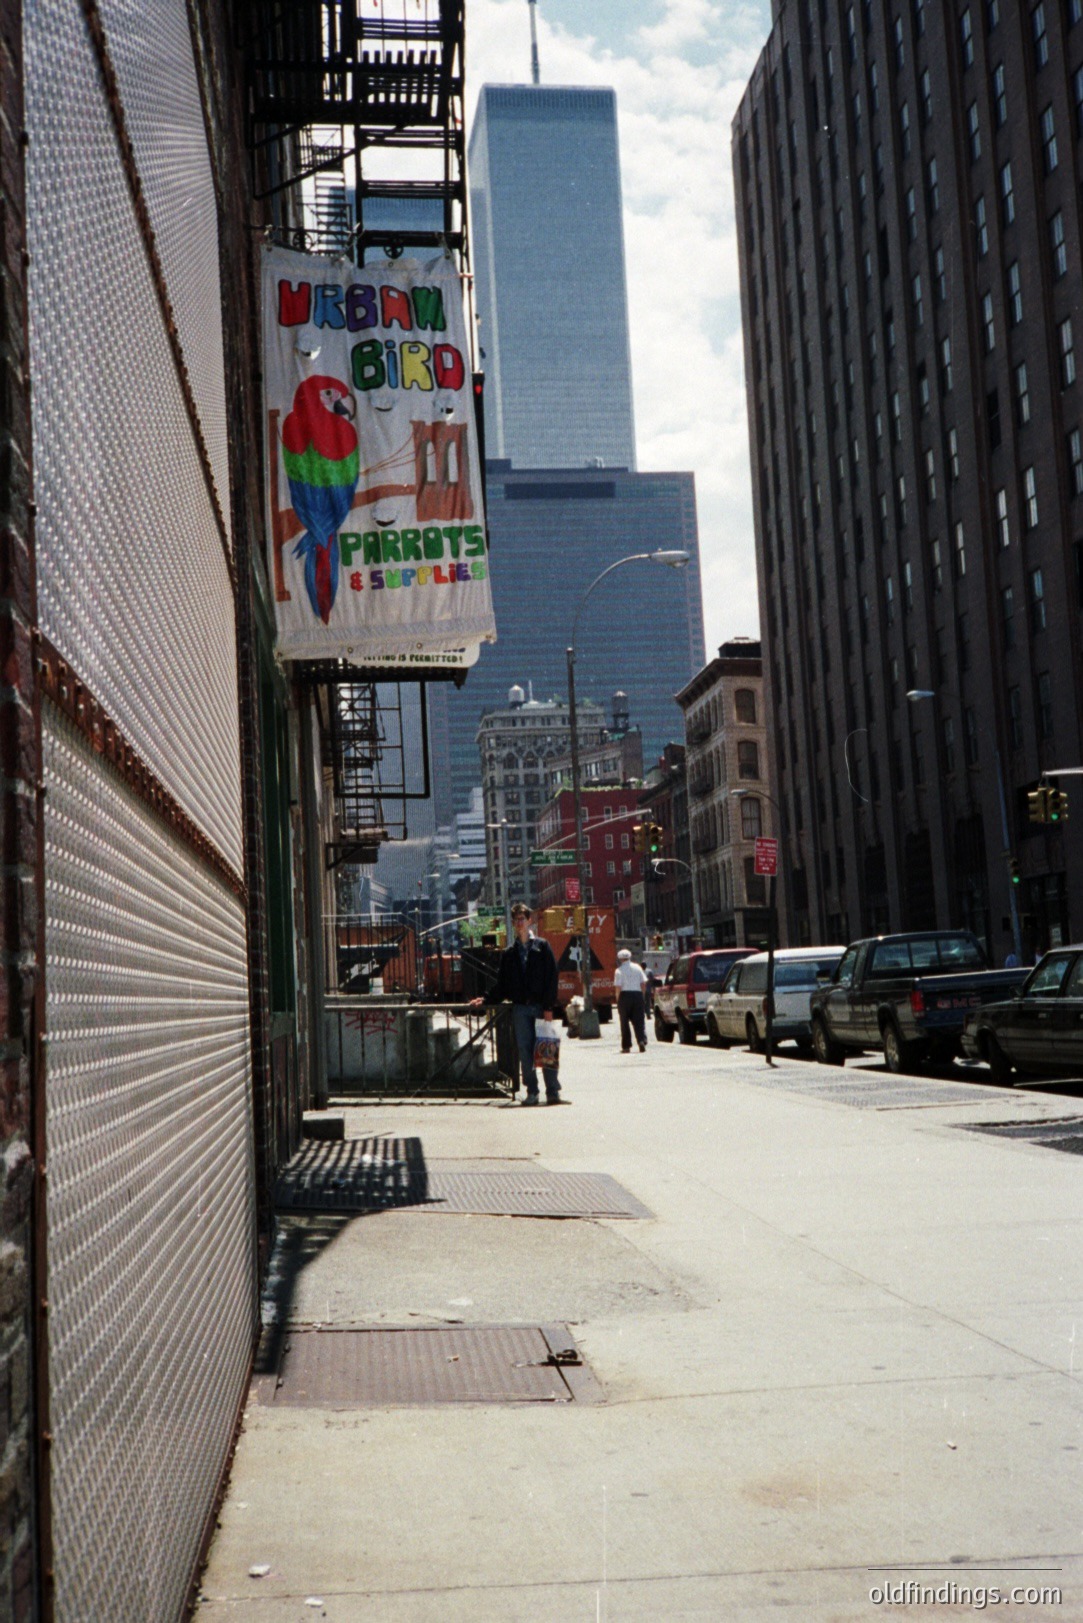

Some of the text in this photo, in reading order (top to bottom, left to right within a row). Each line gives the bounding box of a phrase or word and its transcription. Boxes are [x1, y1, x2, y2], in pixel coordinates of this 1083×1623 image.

[278, 279, 447, 332] URBAN
[339, 525, 486, 567] PARROTS
[350, 571, 364, 592] &
